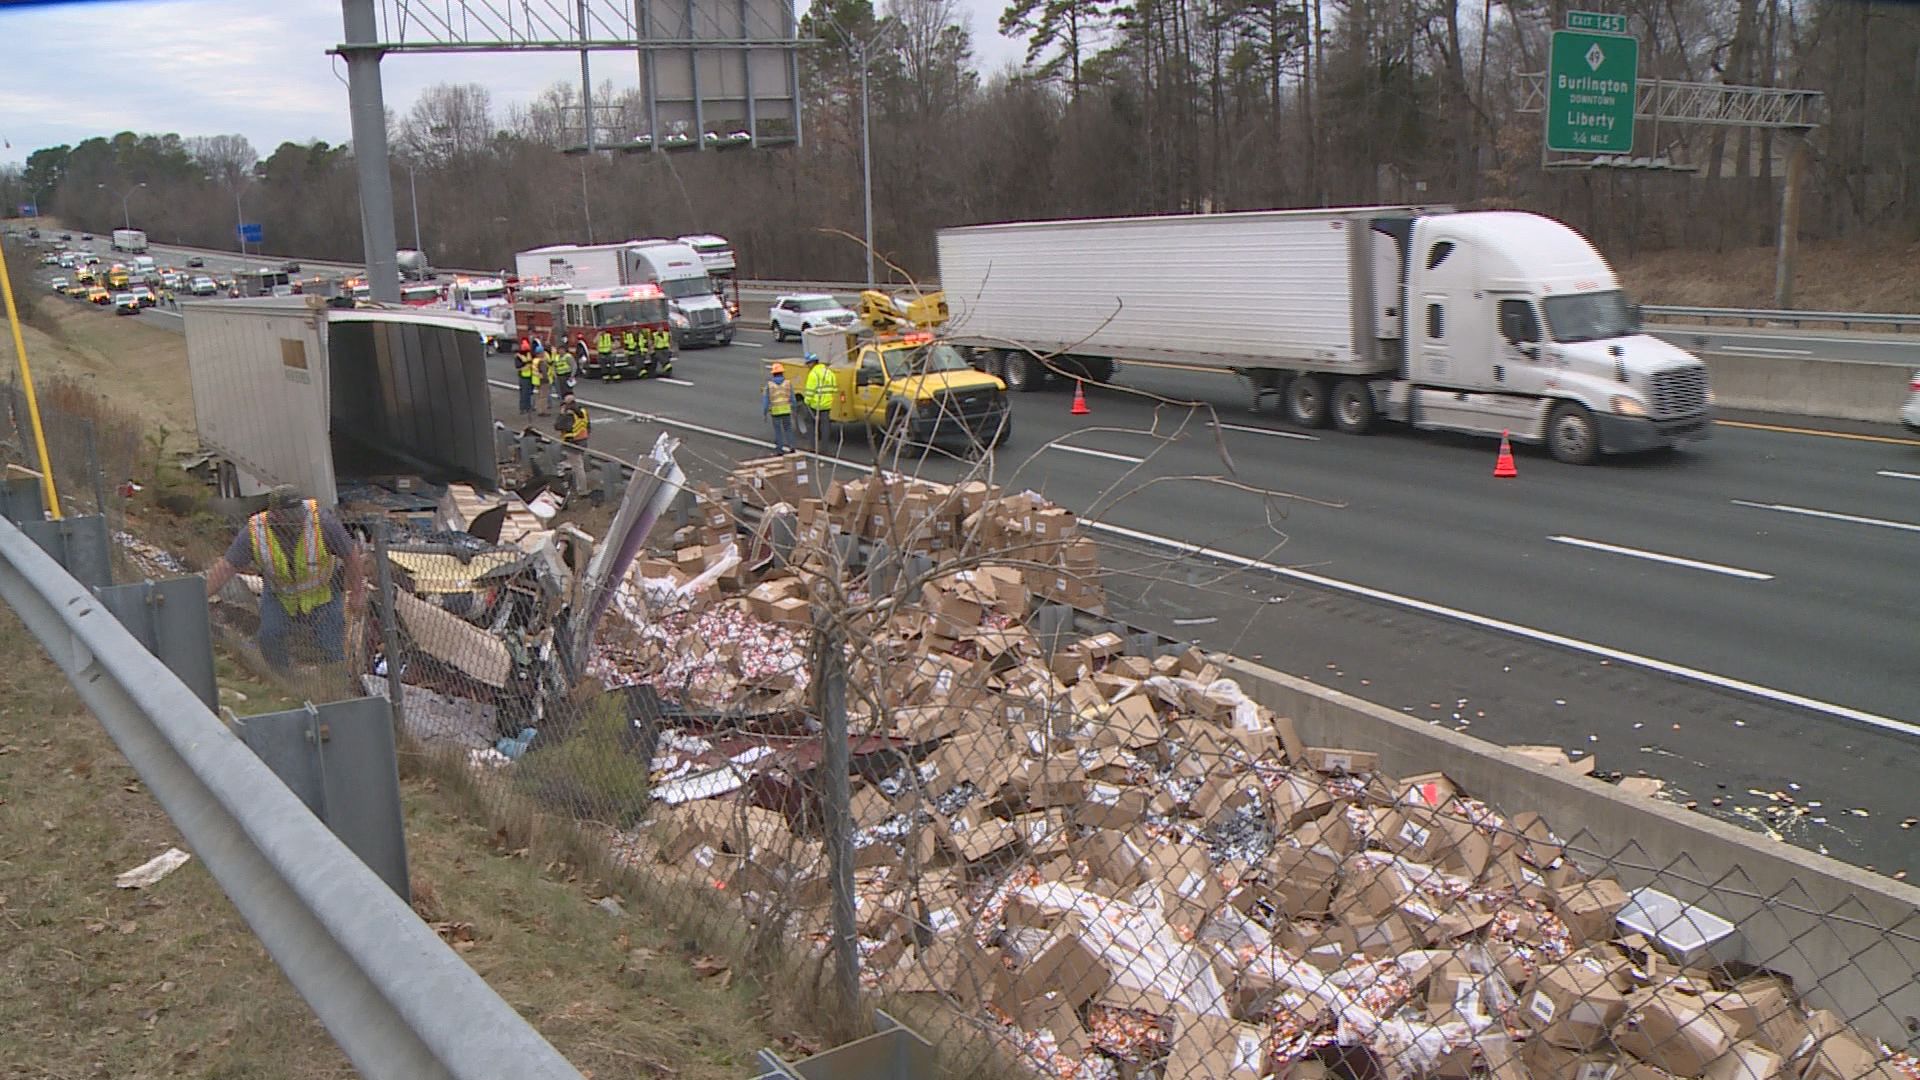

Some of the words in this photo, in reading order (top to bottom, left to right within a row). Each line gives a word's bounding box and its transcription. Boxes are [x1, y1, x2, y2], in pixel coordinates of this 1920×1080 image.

[1571, 15, 1592, 26] EXIT
[1597, 16, 1620, 31] 145
[1558, 74, 1628, 95] Burlington
[1570, 94, 1616, 106] DOWNTOWN
[1567, 111, 1615, 130] Liberty
[1590, 134, 1609, 144] MILE
